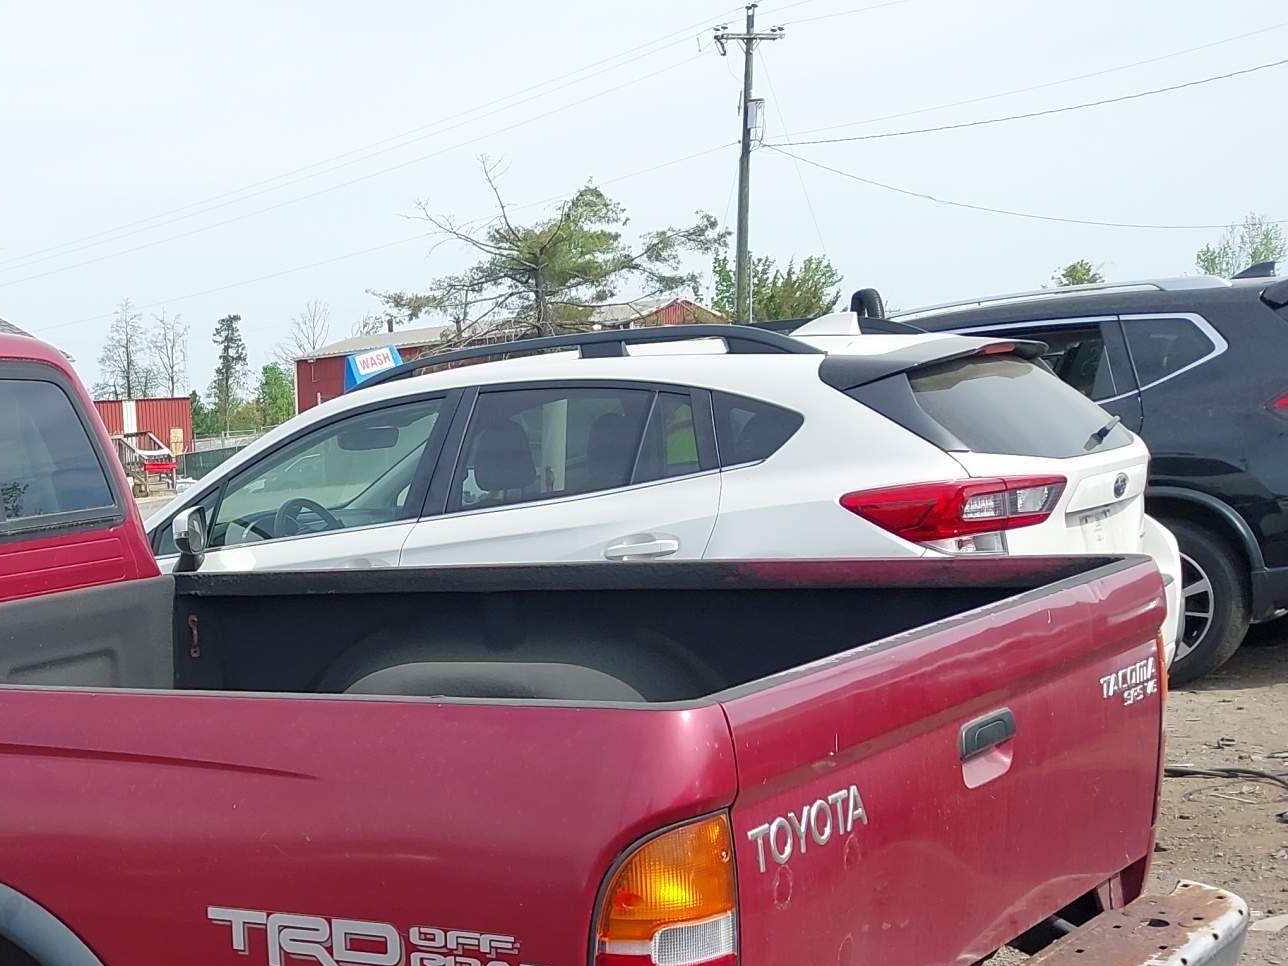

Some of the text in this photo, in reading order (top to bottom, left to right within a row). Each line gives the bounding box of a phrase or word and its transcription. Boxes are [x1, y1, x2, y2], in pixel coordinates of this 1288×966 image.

[358, 352, 392, 371] WASH
[1099, 656, 1156, 699] TACOMA
[746, 784, 868, 873] TOYOTA
[409, 926, 521, 956] OFF
